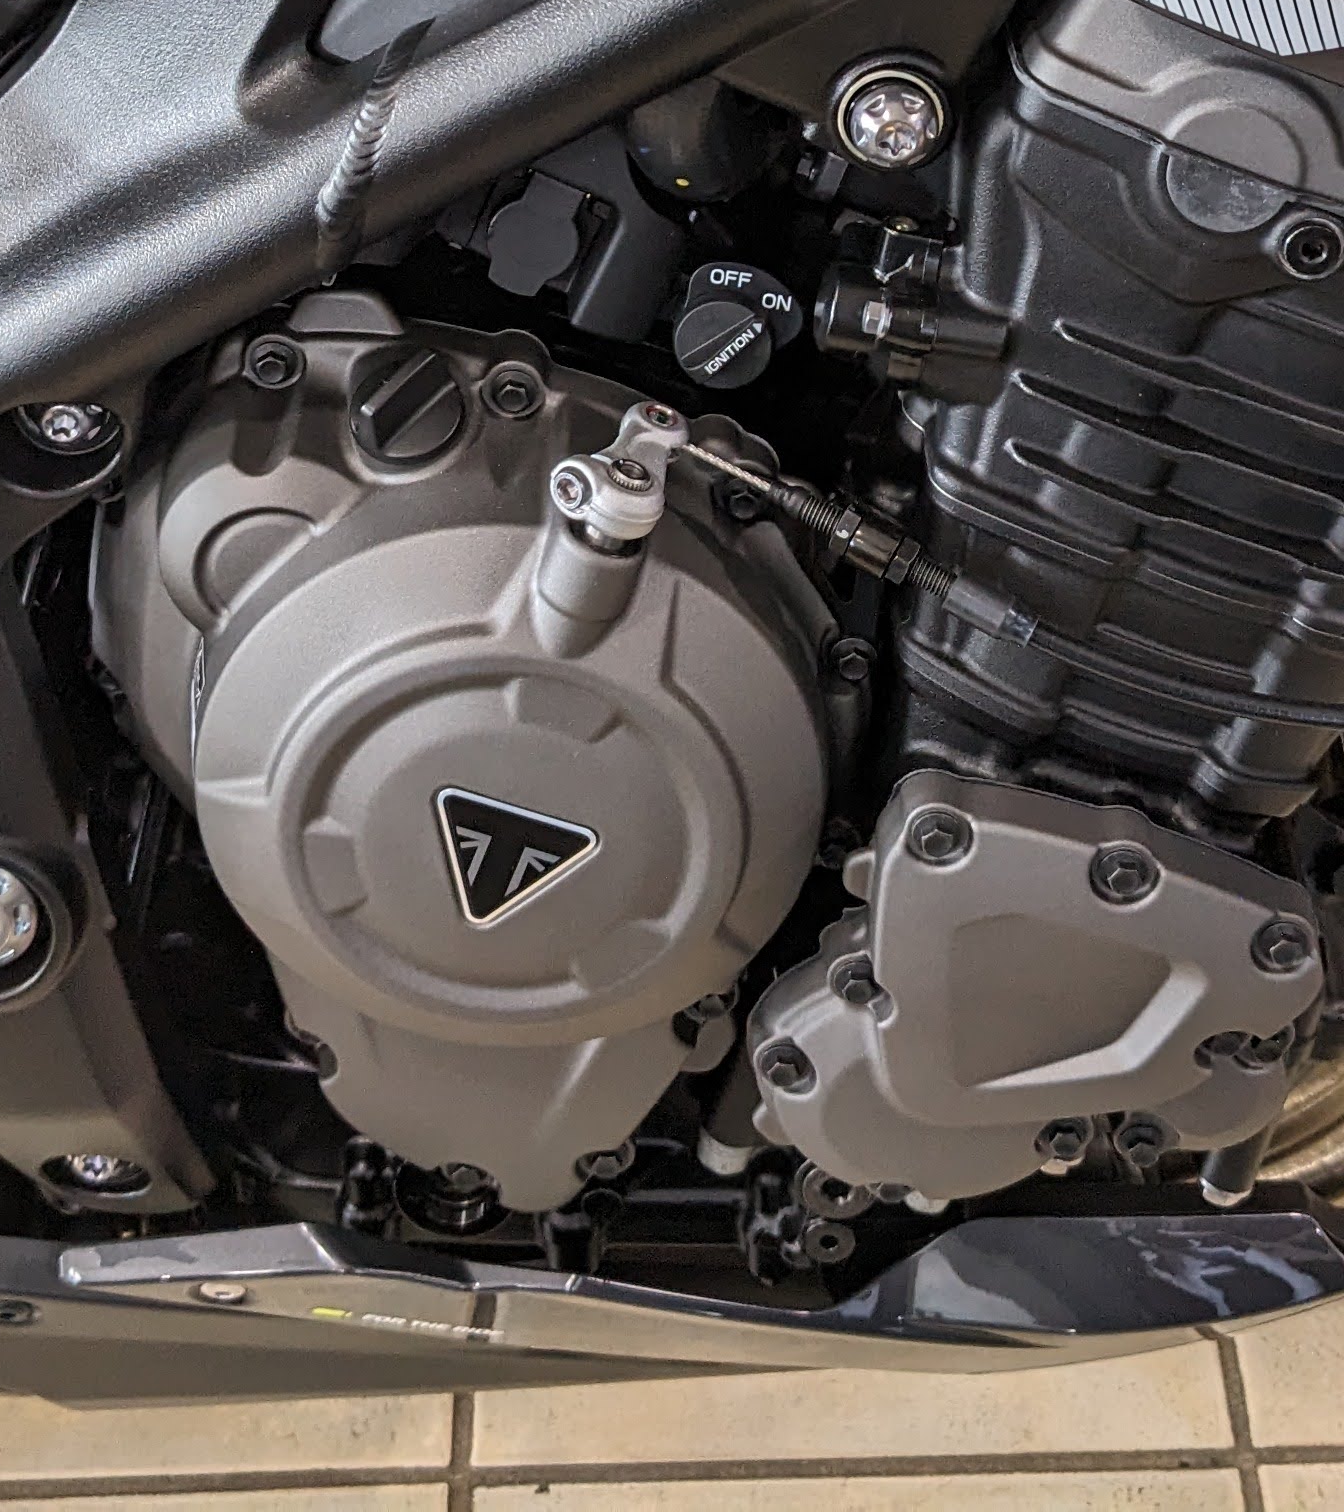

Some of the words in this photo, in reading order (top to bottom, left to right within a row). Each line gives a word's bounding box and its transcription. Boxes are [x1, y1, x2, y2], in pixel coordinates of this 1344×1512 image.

[709, 268, 753, 288] OFF
[761, 292, 793, 312] ON
[704, 328, 756, 375] IGNITION
